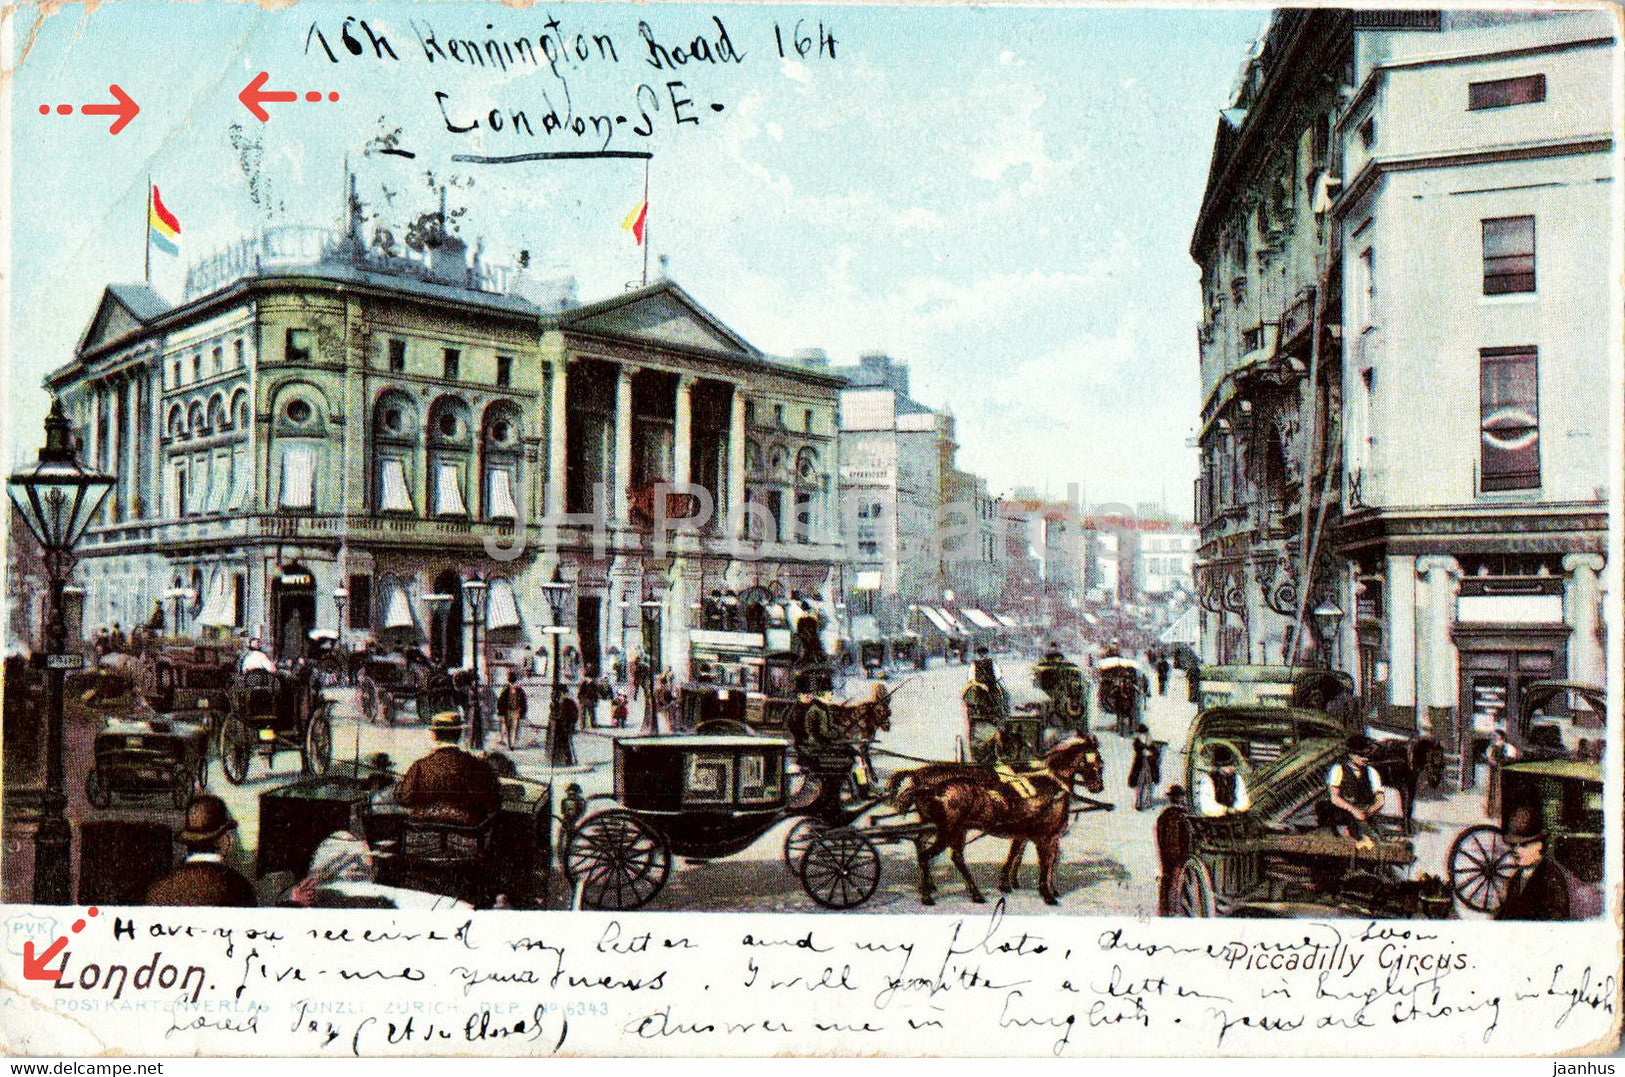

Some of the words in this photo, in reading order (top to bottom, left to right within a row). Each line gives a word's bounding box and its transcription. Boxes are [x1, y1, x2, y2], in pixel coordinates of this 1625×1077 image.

[410, 9, 618, 78] Kennington
[638, 15, 747, 70] Road
[774, 18, 839, 60] 164
[13, 921, 49, 935] PVK
[54, 951, 216, 1003] London.
[1229, 941, 1364, 977] Piccadilly
[1378, 943, 1476, 970] Circus.
[565, 1001, 609, 1015] 6343
